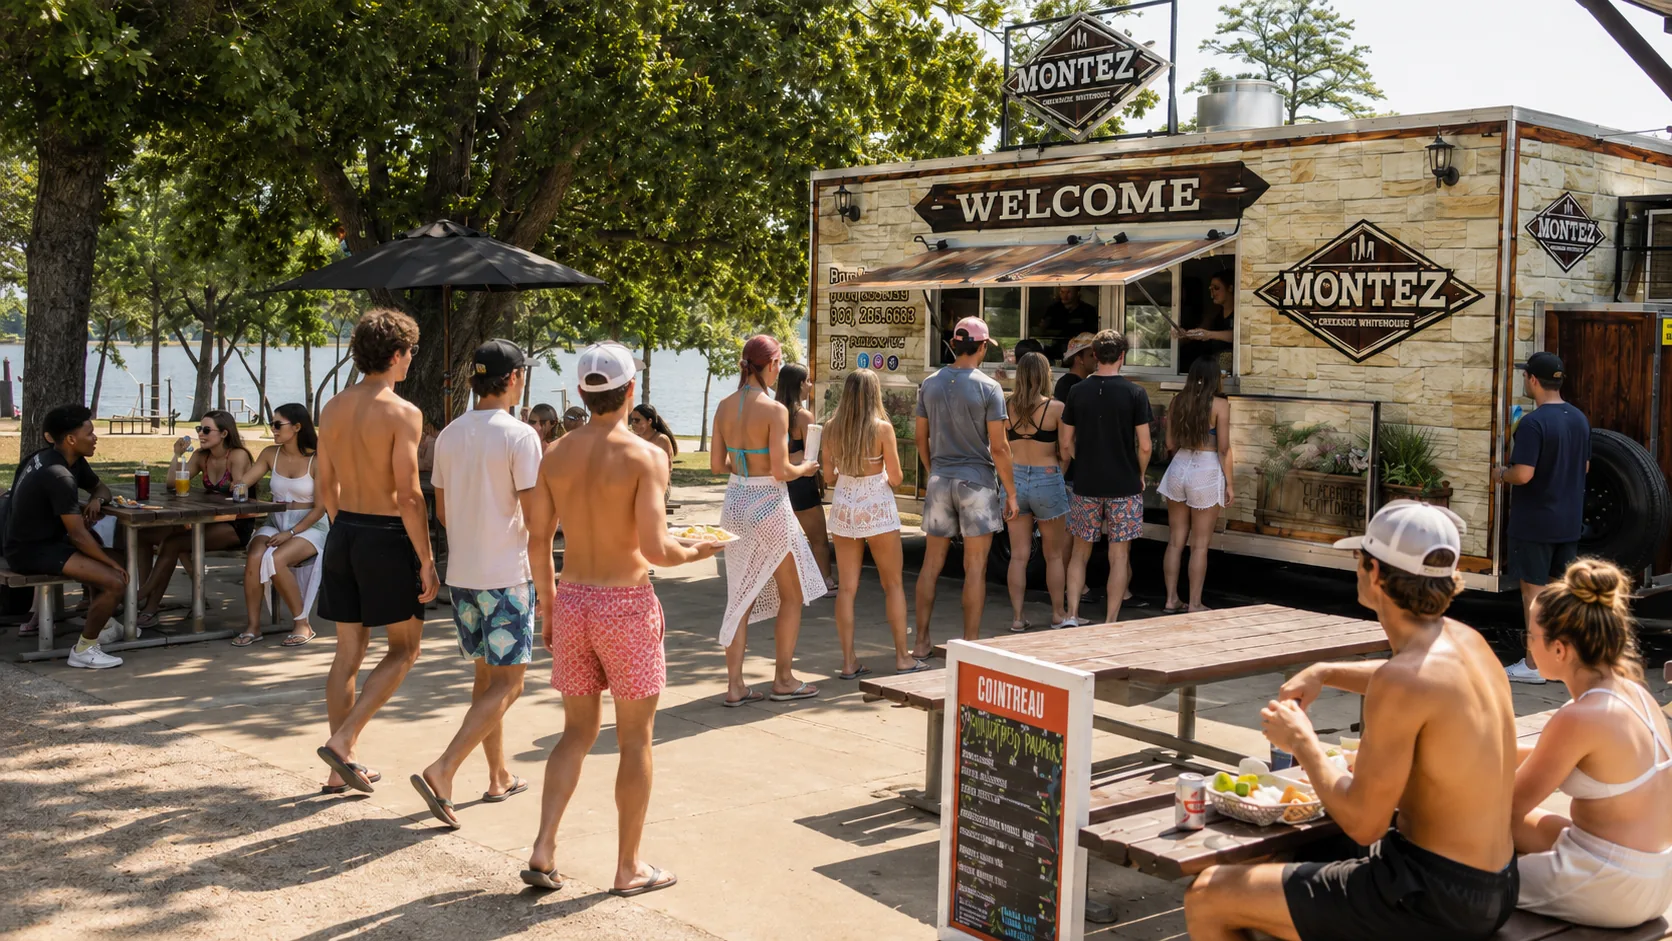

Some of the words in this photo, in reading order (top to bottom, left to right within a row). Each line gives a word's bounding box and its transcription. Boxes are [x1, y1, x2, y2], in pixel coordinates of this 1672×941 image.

[1017, 49, 1137, 94] MONTEZ
[956, 177, 1200, 223] WELCOME
[1537, 217, 1598, 244] MONTEZ
[1283, 271, 1448, 308] MONTEZ
[977, 675, 1045, 719] COINTREAU
